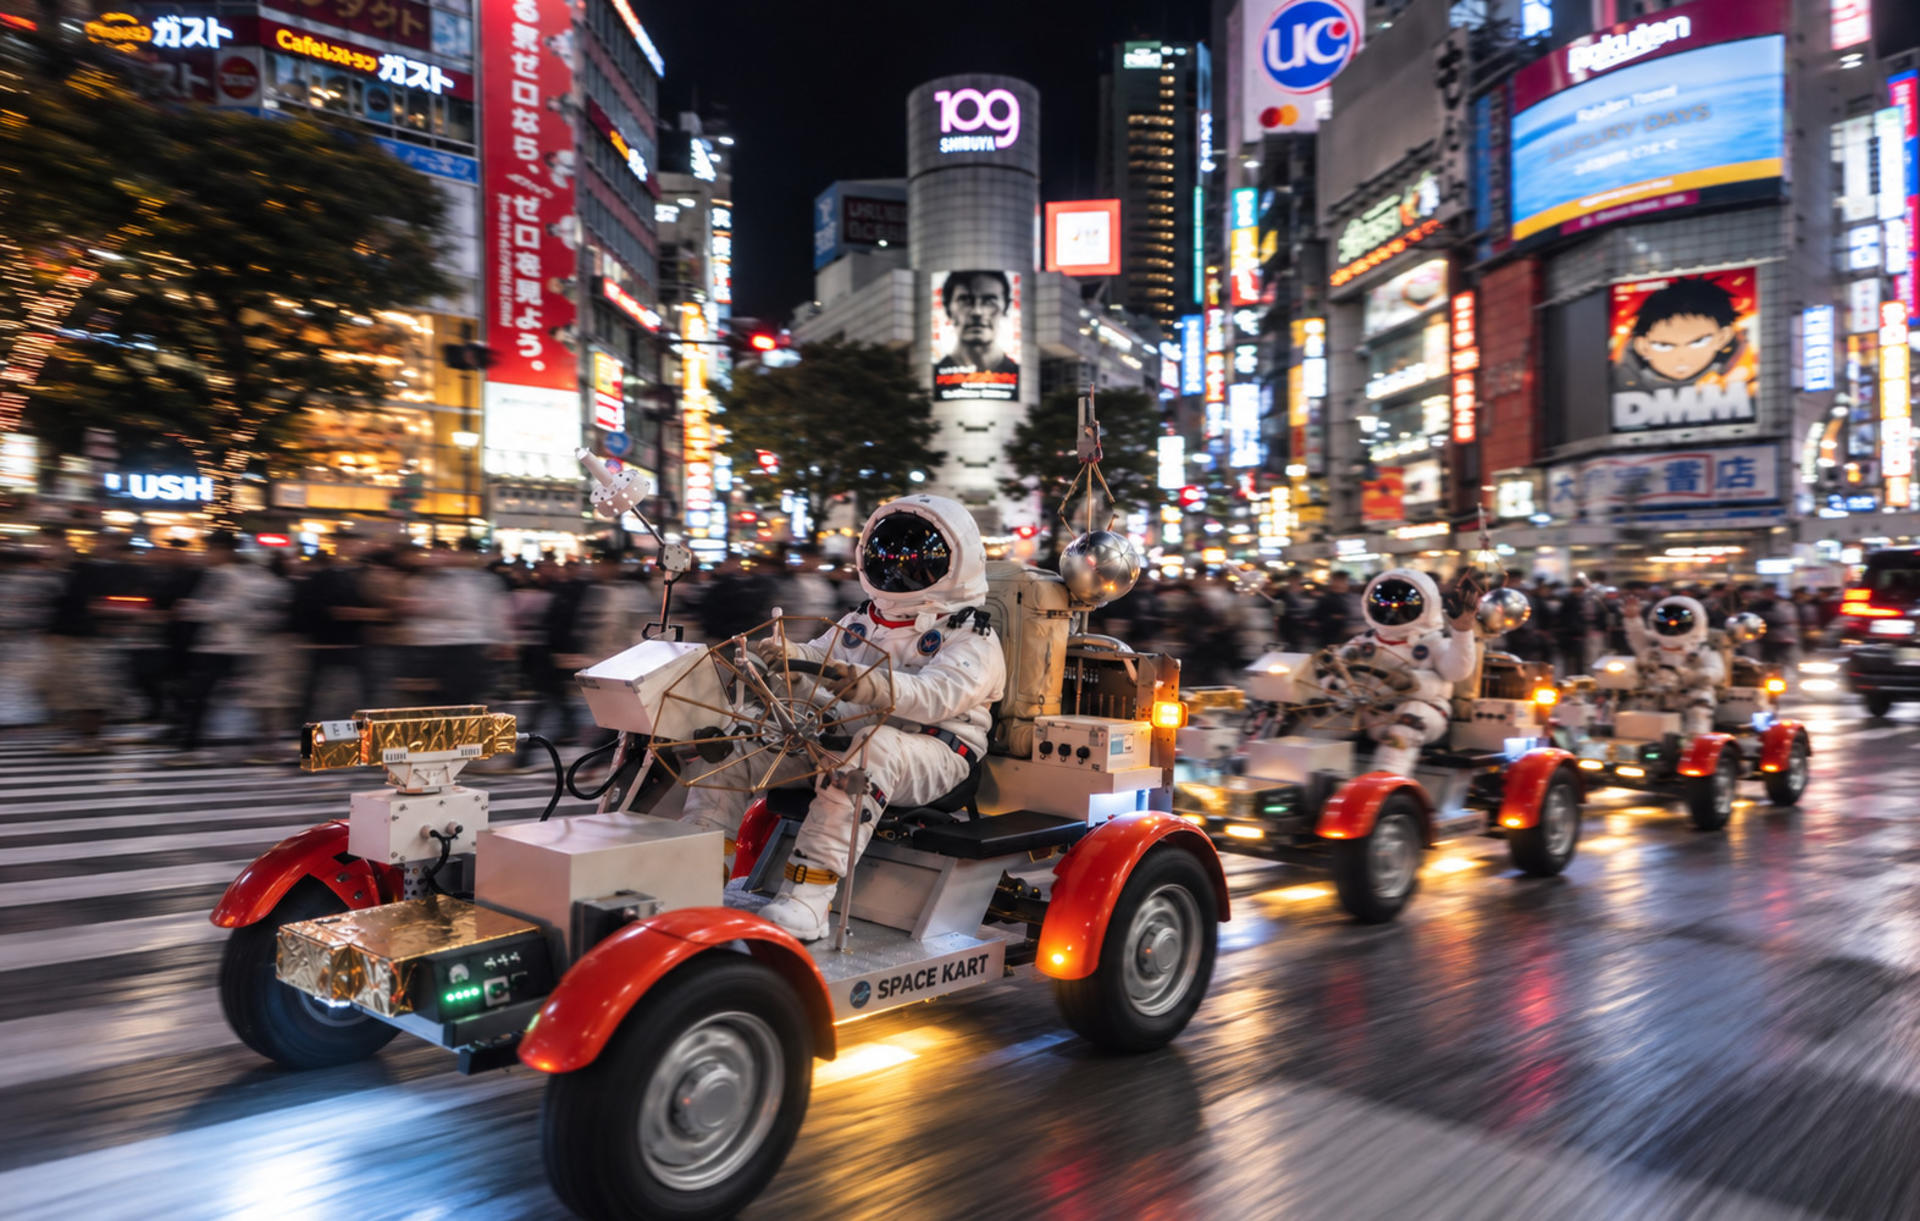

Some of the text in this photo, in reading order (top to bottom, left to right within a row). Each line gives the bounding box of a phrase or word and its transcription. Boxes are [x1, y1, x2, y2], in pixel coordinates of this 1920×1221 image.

[151, 14, 234, 49] ガスト
[1567, 15, 1691, 74] Rakuten
[377, 53, 455, 95] ガスト
[934, 87, 1020, 149] 109
[940, 135, 996, 153] SHIBUYA
[1612, 382, 1756, 428] DMM
[877, 953, 990, 1000] SPACE KART
